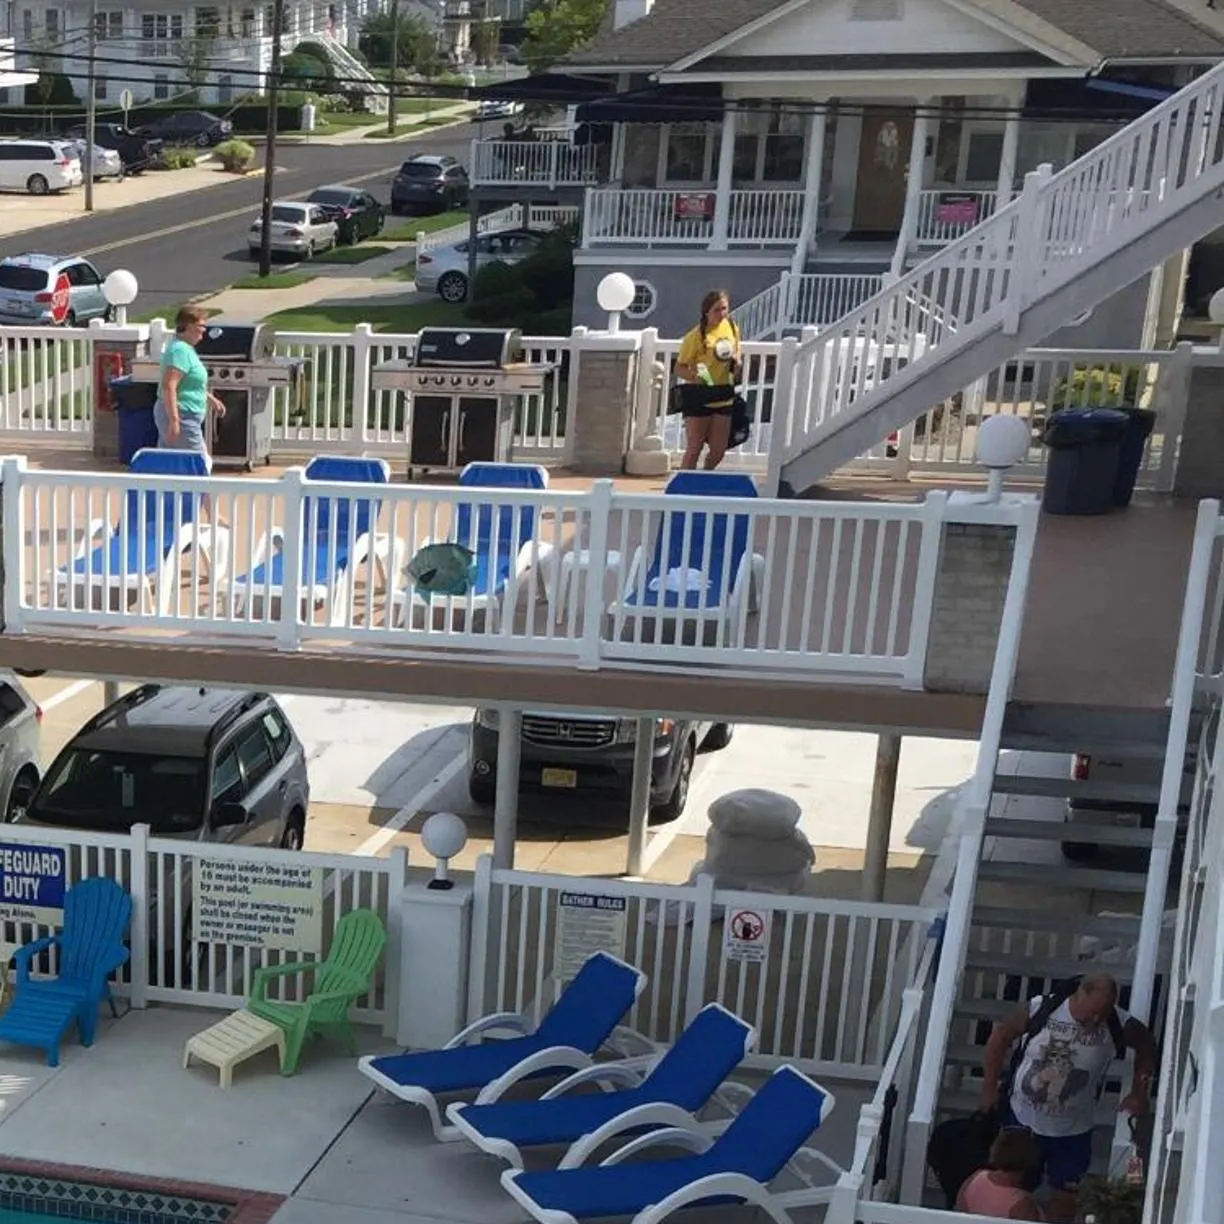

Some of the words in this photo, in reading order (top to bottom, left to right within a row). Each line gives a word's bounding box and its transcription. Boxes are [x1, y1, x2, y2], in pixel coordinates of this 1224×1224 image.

[200, 859, 235, 871] Persons
[238, 862, 264, 874] under
[266, 864, 280, 875] the
[283, 867, 299, 878] age
[302, 868, 311, 877] of
[3, 876, 41, 900] DUTY
[200, 881, 211, 892] by
[213, 884, 224, 892] an
[215, 872, 236, 881] must
[238, 873, 250, 882] be
[252, 877, 312, 889] accompanied
[282, 915, 295, 924] the
